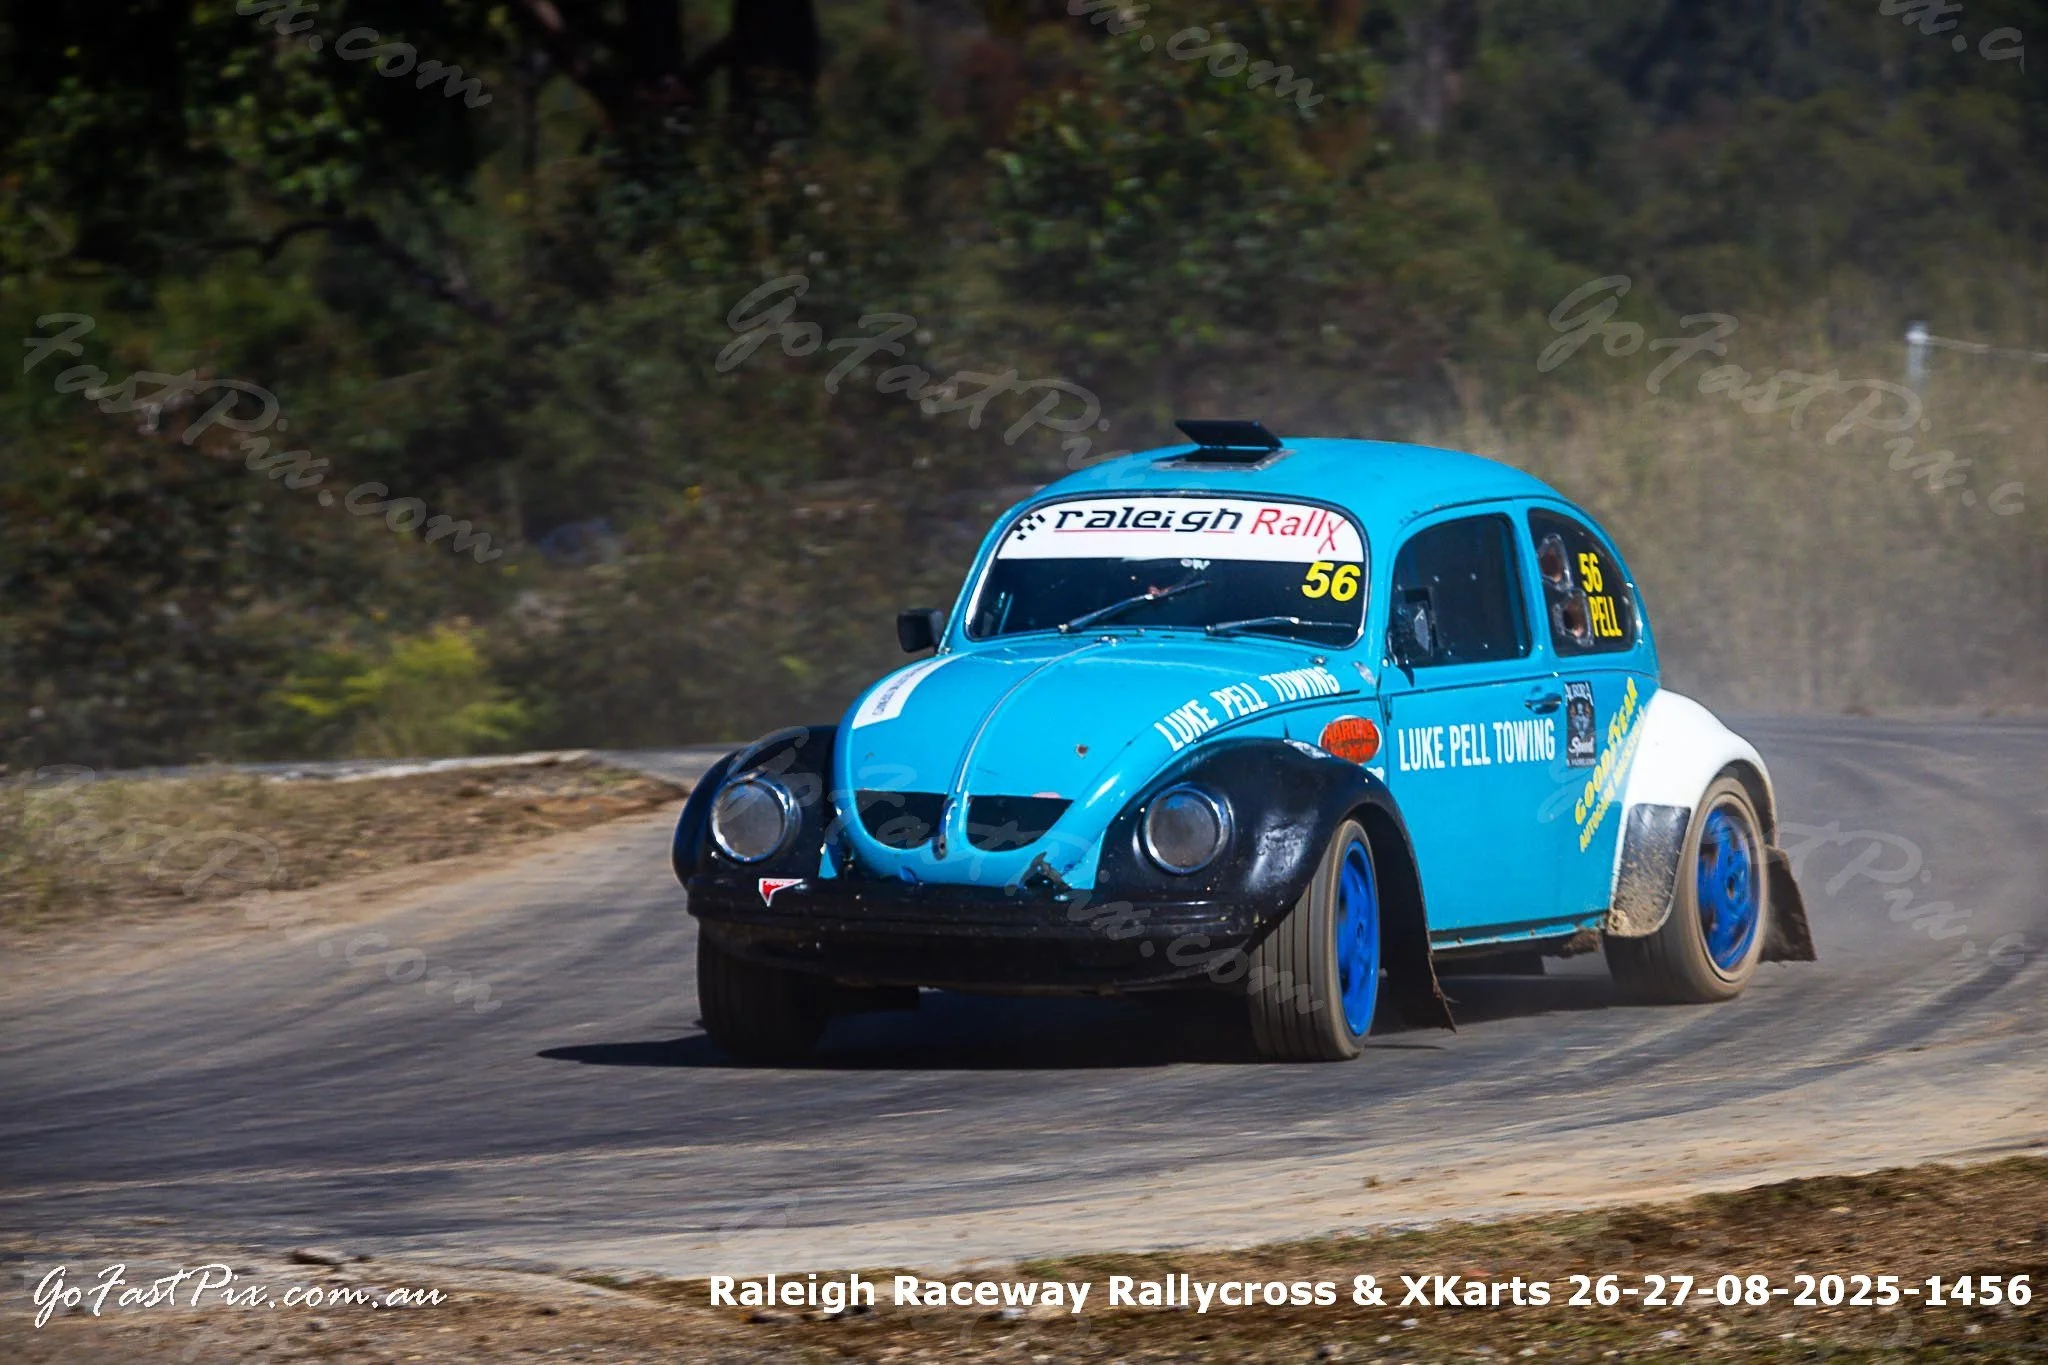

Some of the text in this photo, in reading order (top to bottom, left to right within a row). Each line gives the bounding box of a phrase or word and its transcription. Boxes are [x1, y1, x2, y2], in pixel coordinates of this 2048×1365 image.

[1054, 507, 1243, 532] raleigh
[1302, 561, 1361, 602] 56
[1577, 552, 1604, 593] 56
[1588, 596, 1624, 638] PELL
[1153, 666, 1341, 752] LUKE PELL TOWING
[1397, 726, 1446, 772] LUKE
[1449, 722, 1492, 768] PELL
[1493, 718, 1556, 764] TOWING
[1574, 676, 1639, 825] GOODYEAR
